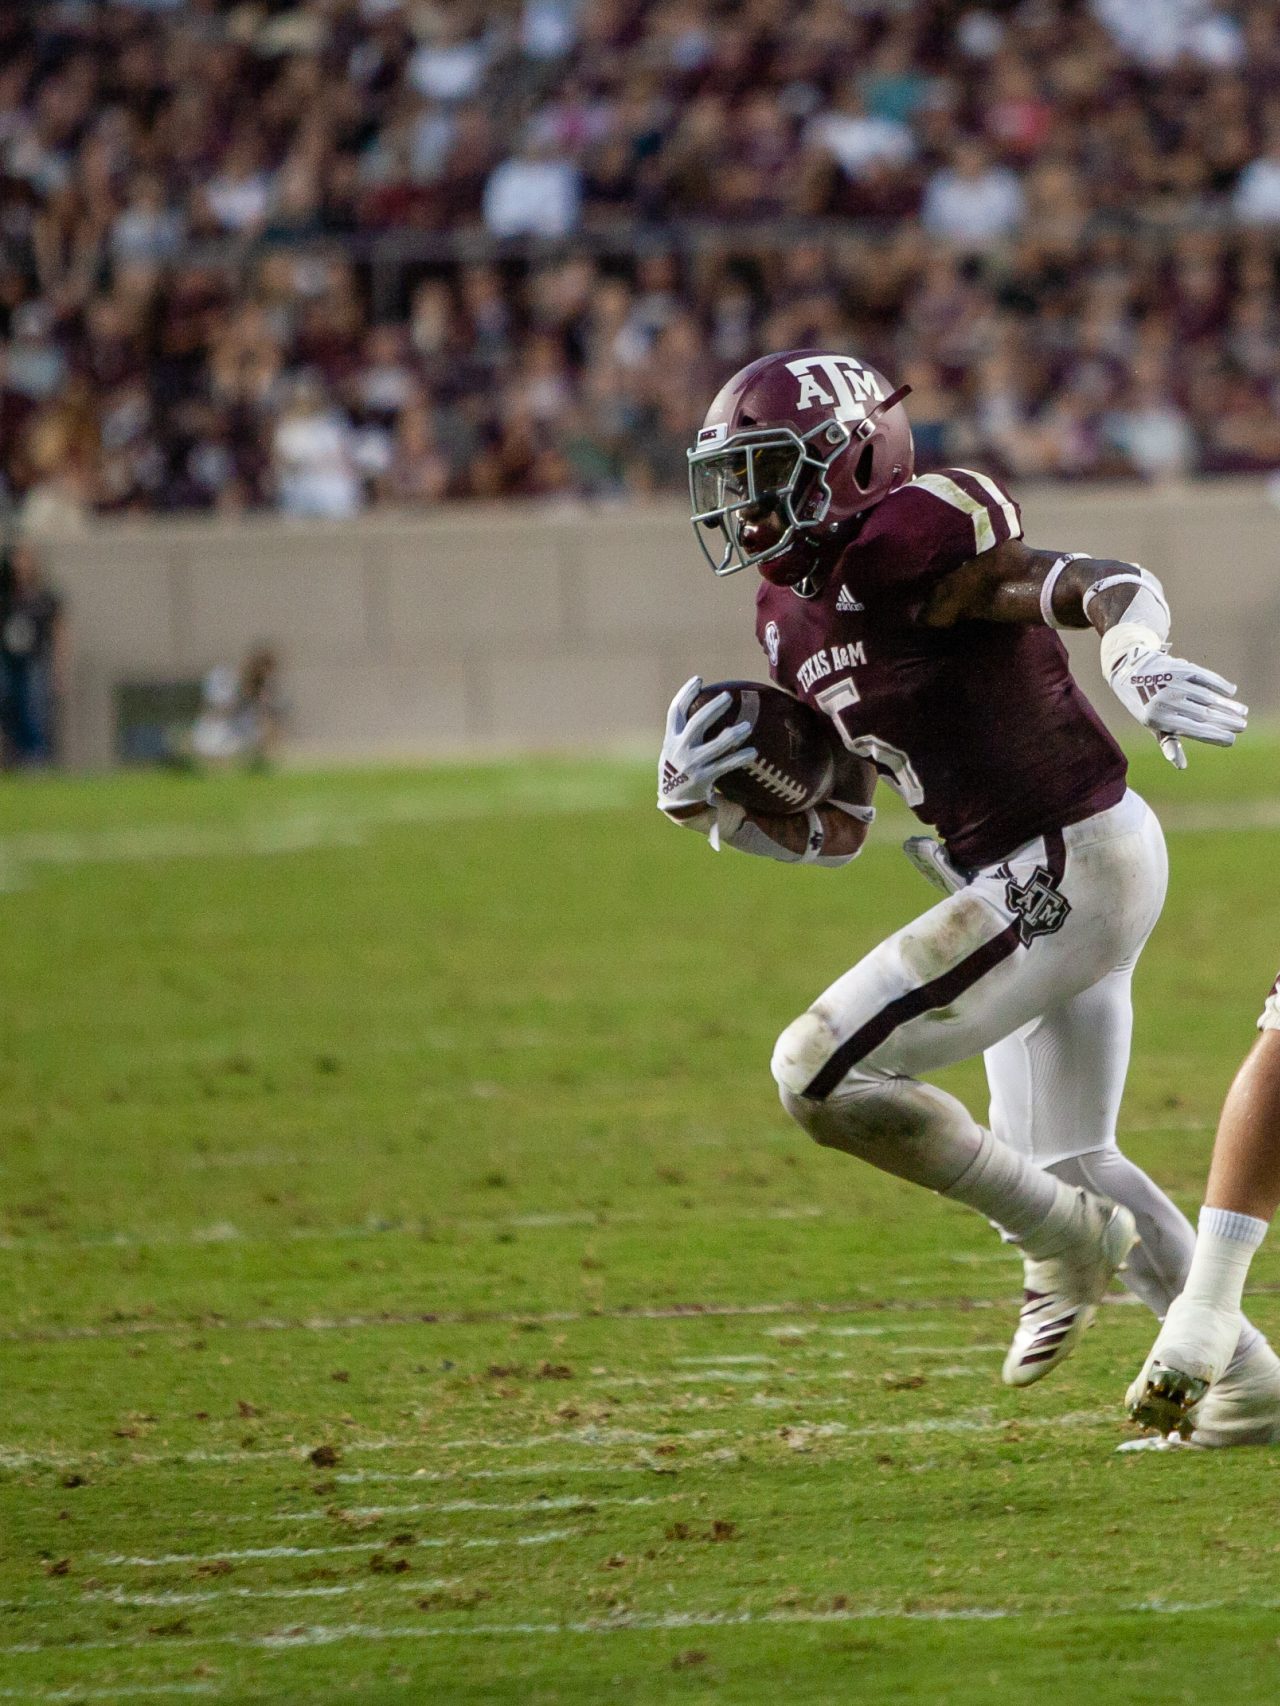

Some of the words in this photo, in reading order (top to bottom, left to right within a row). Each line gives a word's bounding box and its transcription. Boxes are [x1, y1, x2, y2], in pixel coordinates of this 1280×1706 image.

[796, 649, 832, 694] TEXAS
[830, 640, 868, 673] A&M
[1130, 672, 1174, 685] adidas
[662, 773, 690, 795] adidas
